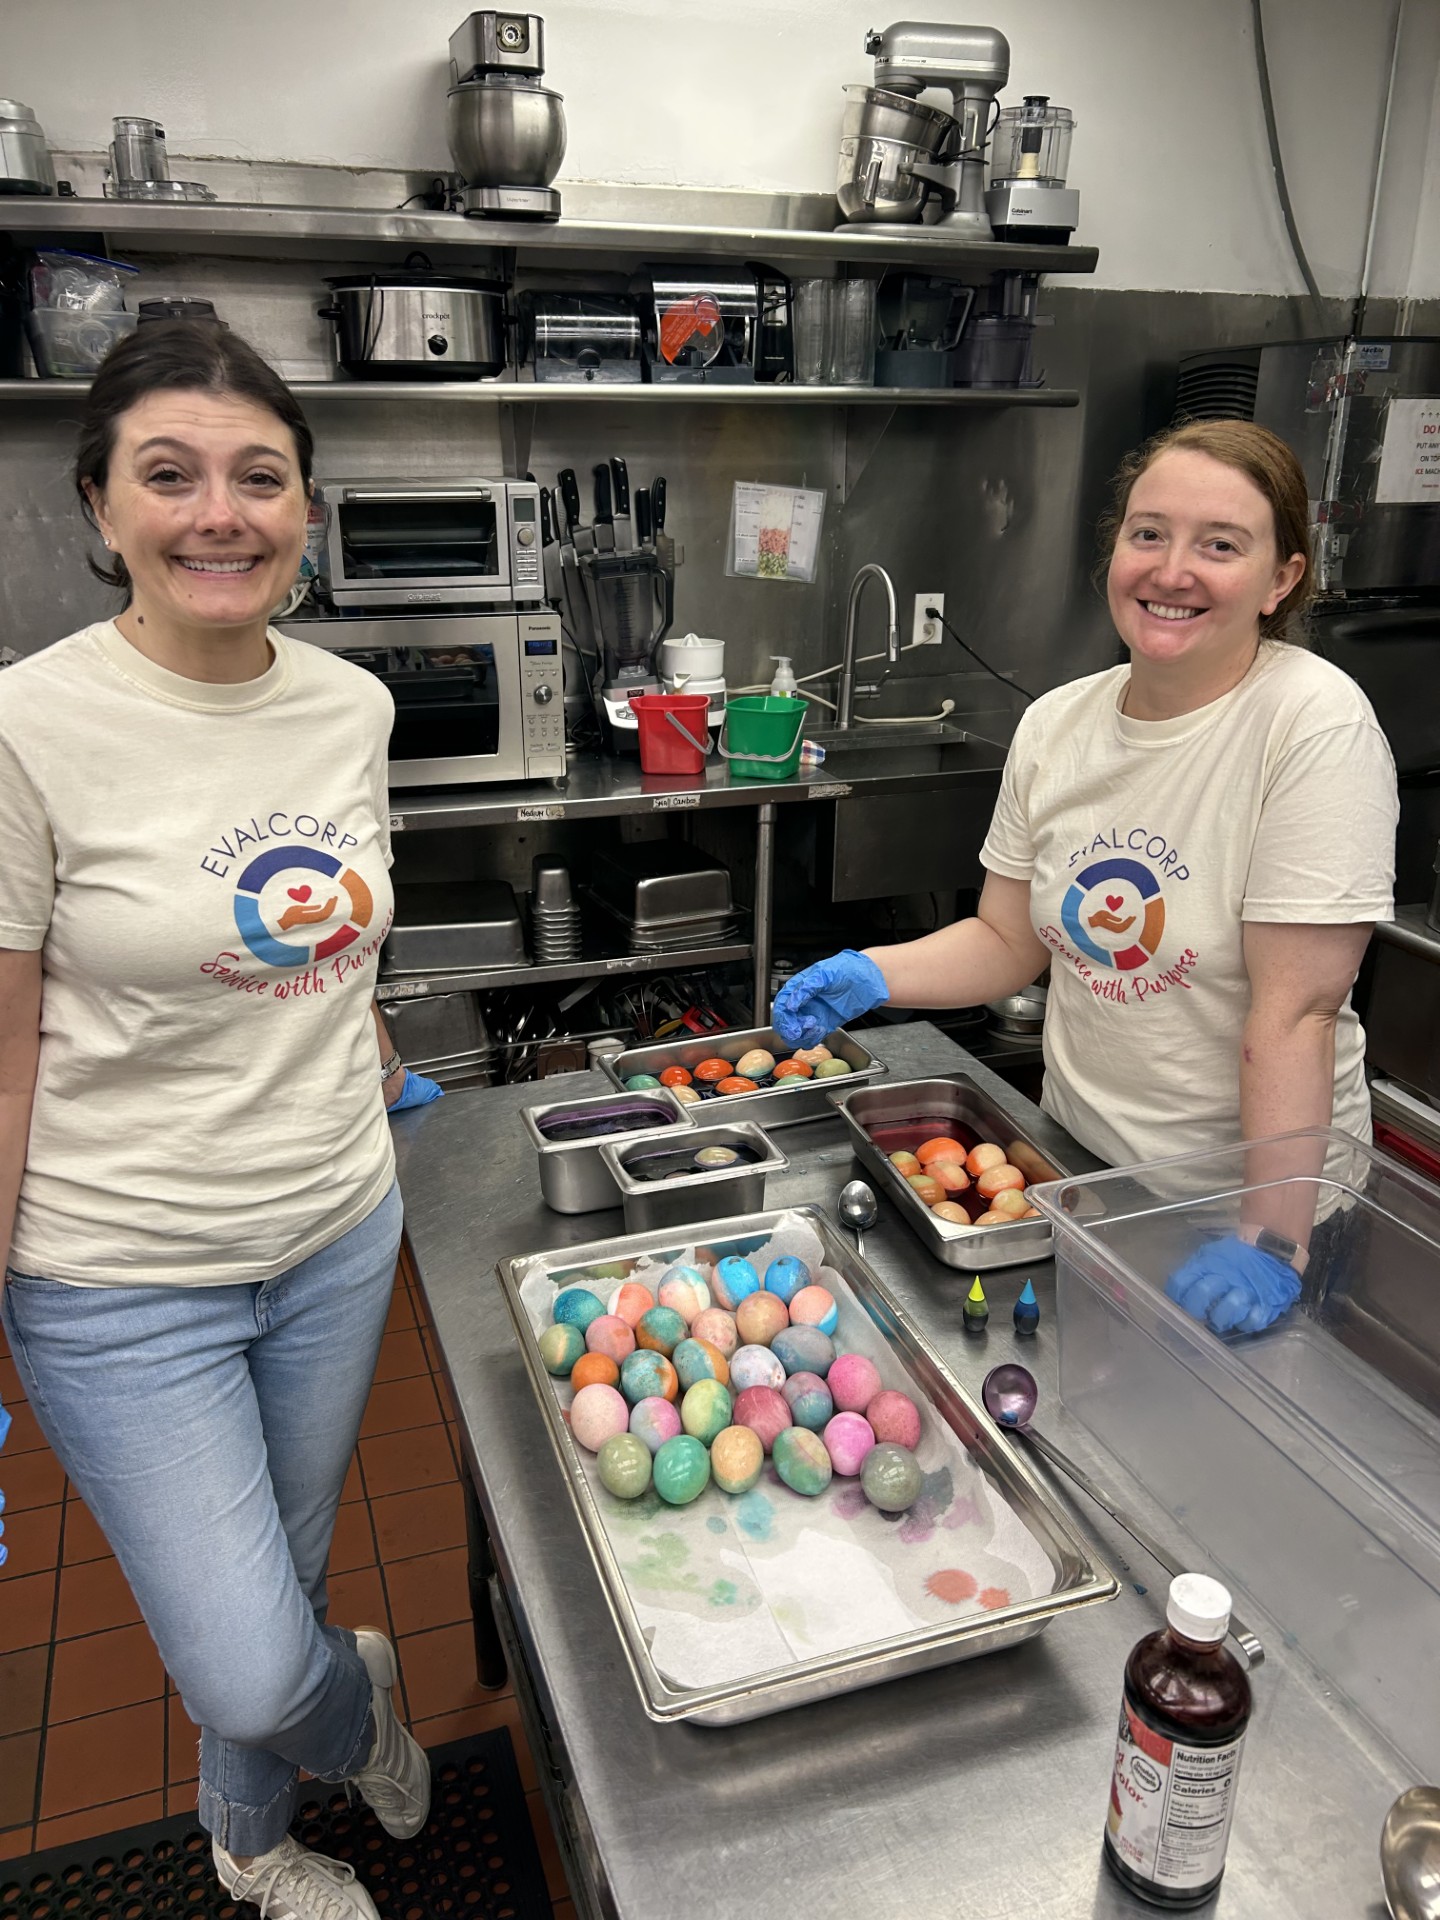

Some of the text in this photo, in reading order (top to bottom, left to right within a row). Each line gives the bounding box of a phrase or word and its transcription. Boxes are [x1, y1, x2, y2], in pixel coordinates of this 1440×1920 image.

[421, 312, 451, 322] crockpot
[1423, 424, 1437, 434] DO
[200, 812, 358, 878] EVALCORP
[1039, 925, 1199, 1005] Service with Purpose
[199, 951, 270, 995] Service
[273, 967, 327, 1000] with
[1176, 1750, 1215, 1764] Nutrition
[1172, 1778, 1231, 1795] Calories 0
